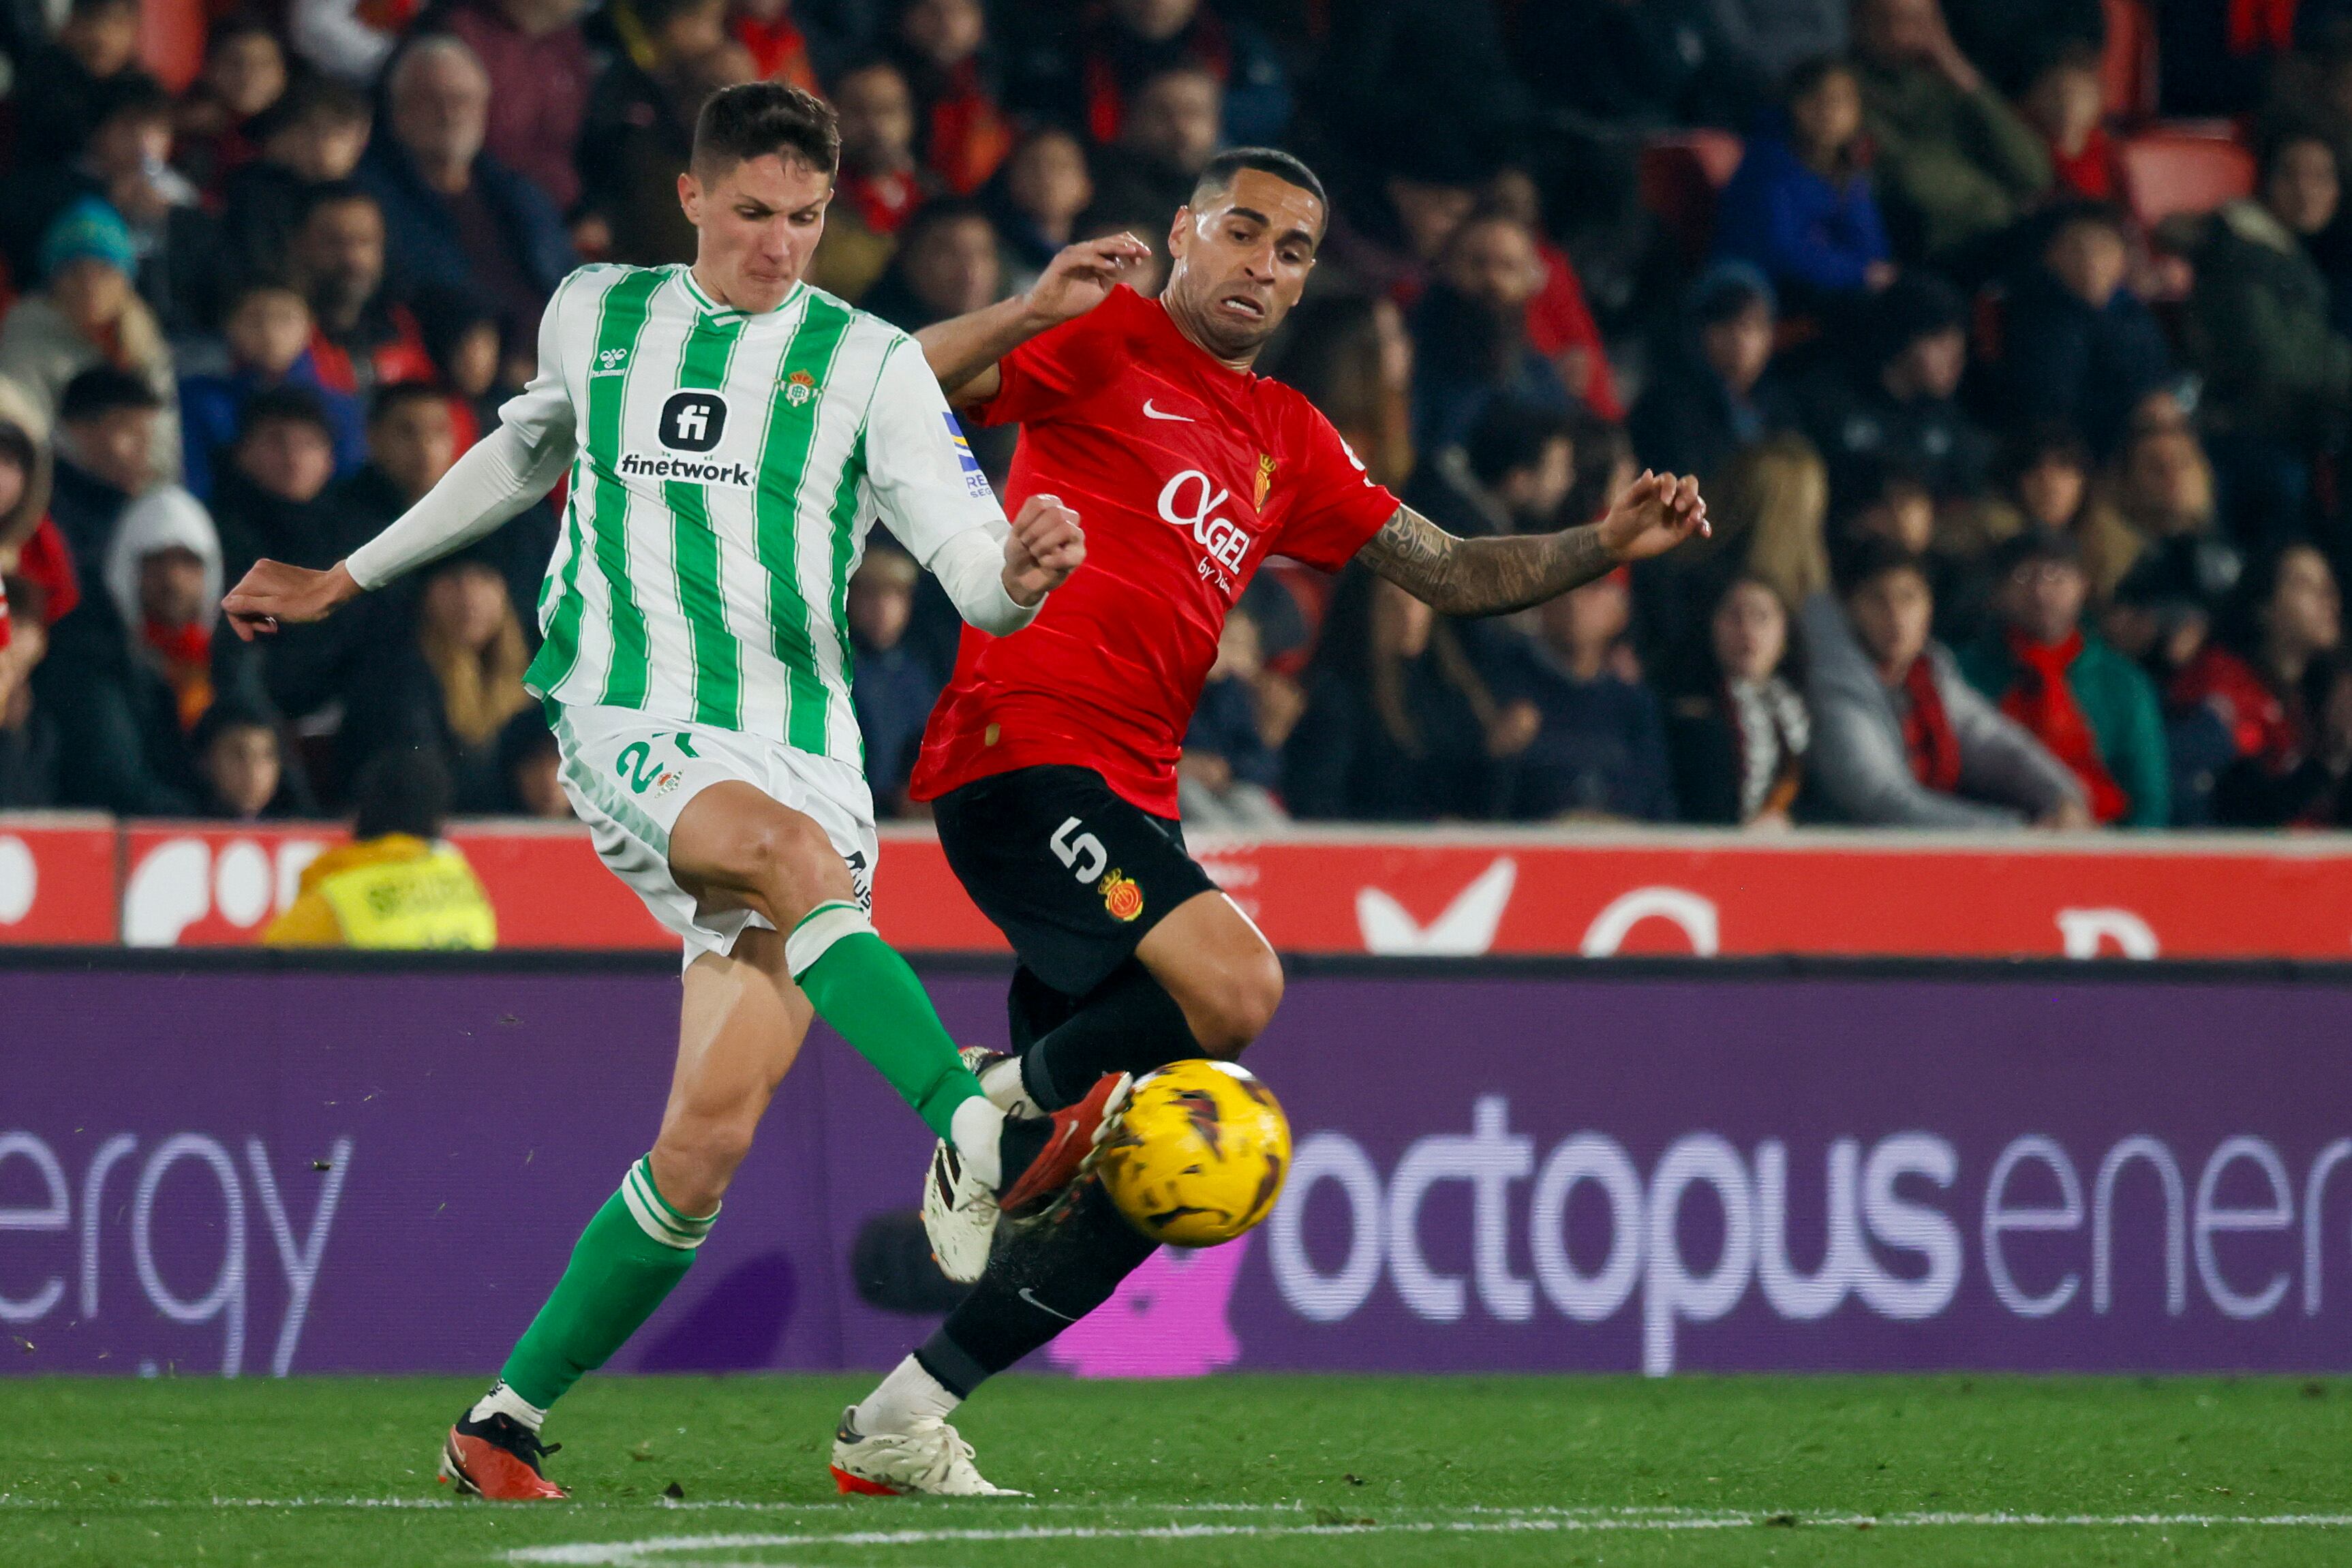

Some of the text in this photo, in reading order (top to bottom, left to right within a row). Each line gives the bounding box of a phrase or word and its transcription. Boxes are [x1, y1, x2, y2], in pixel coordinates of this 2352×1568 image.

[676, 404, 711, 441] fi
[622, 454, 750, 487] finetwork
[1197, 556, 1215, 581] by
[1050, 816, 1108, 884] 5
[1268, 1095, 1963, 1377] octopus
